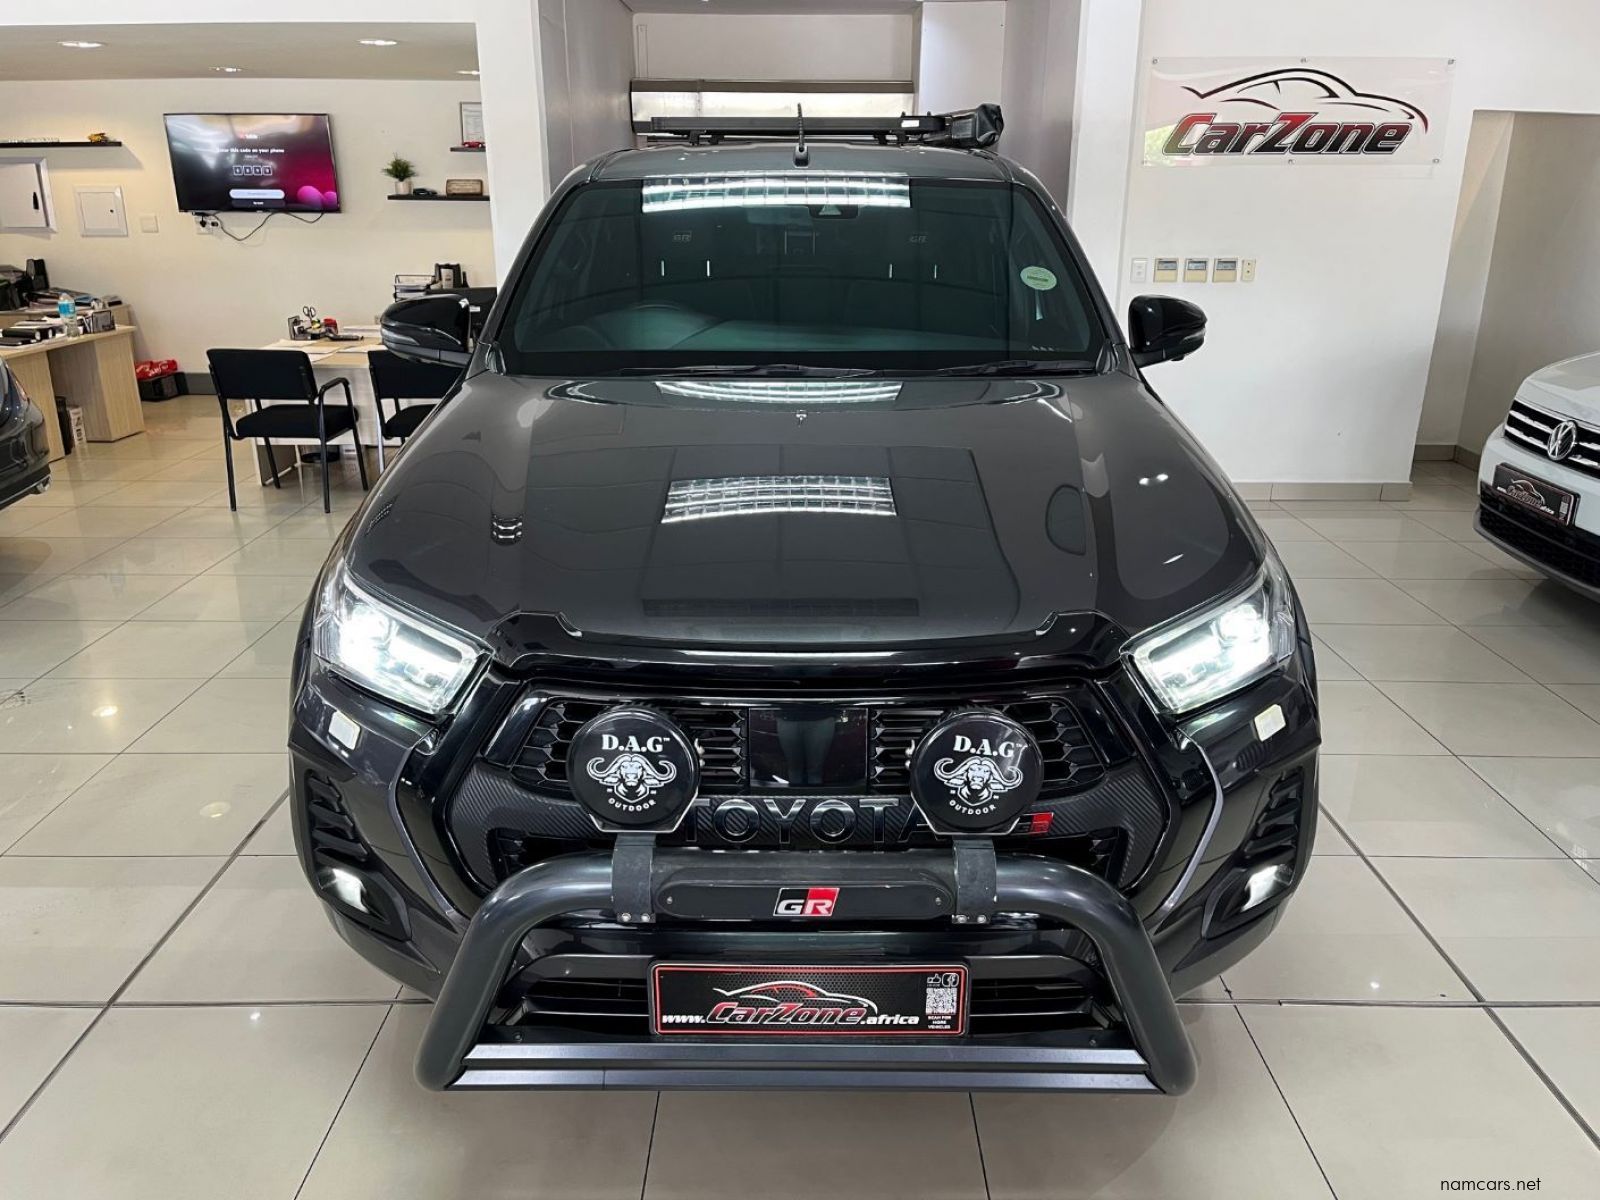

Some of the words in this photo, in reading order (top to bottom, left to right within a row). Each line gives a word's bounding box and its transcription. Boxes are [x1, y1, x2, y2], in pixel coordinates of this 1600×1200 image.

[1162, 111, 1413, 156] CarZone
[607, 797, 657, 812] OUTDOOR
[949, 800, 997, 815] OUTDOOR
[776, 898, 833, 915] GR
